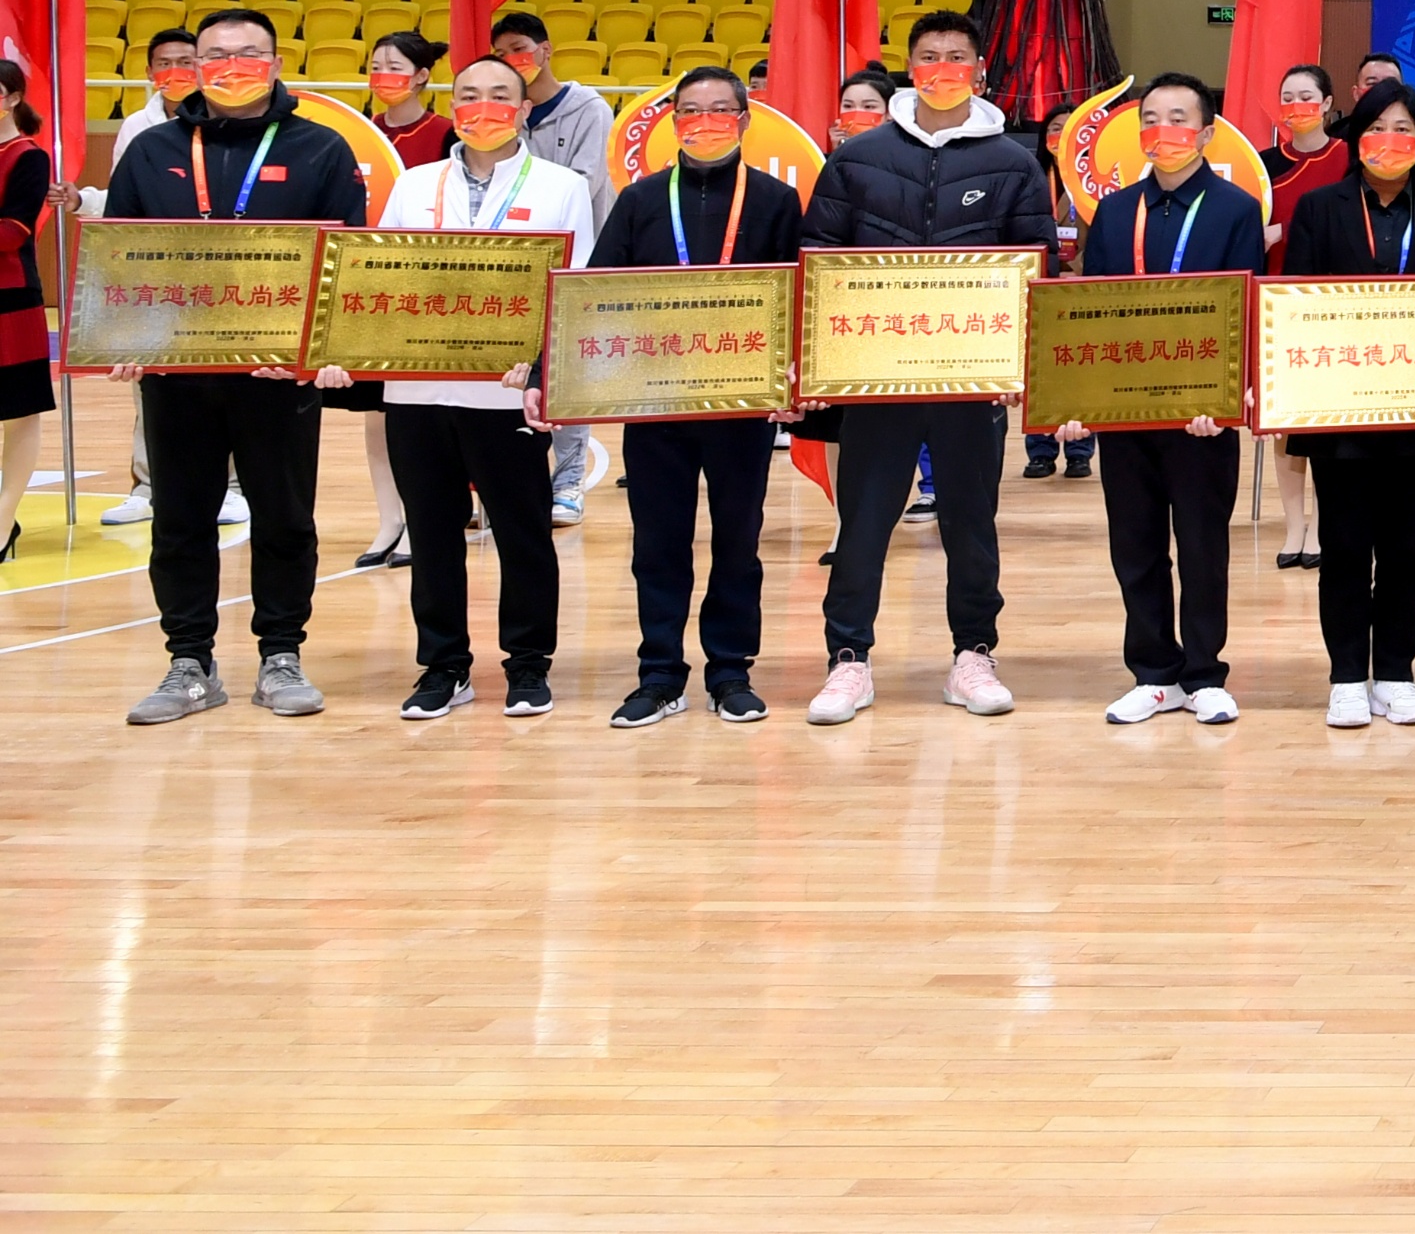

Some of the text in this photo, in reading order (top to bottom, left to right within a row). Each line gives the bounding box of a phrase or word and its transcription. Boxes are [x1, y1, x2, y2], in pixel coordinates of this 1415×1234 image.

[103, 284, 302, 307] 体育道德风尚奖
[341, 292, 532, 318] 体育道德风尚奖
[829, 312, 1013, 336] 体育道德风尚奖
[578, 330, 768, 359] 体育道德风尚奖
[1052, 337, 1220, 367] 体育道德风尚奖
